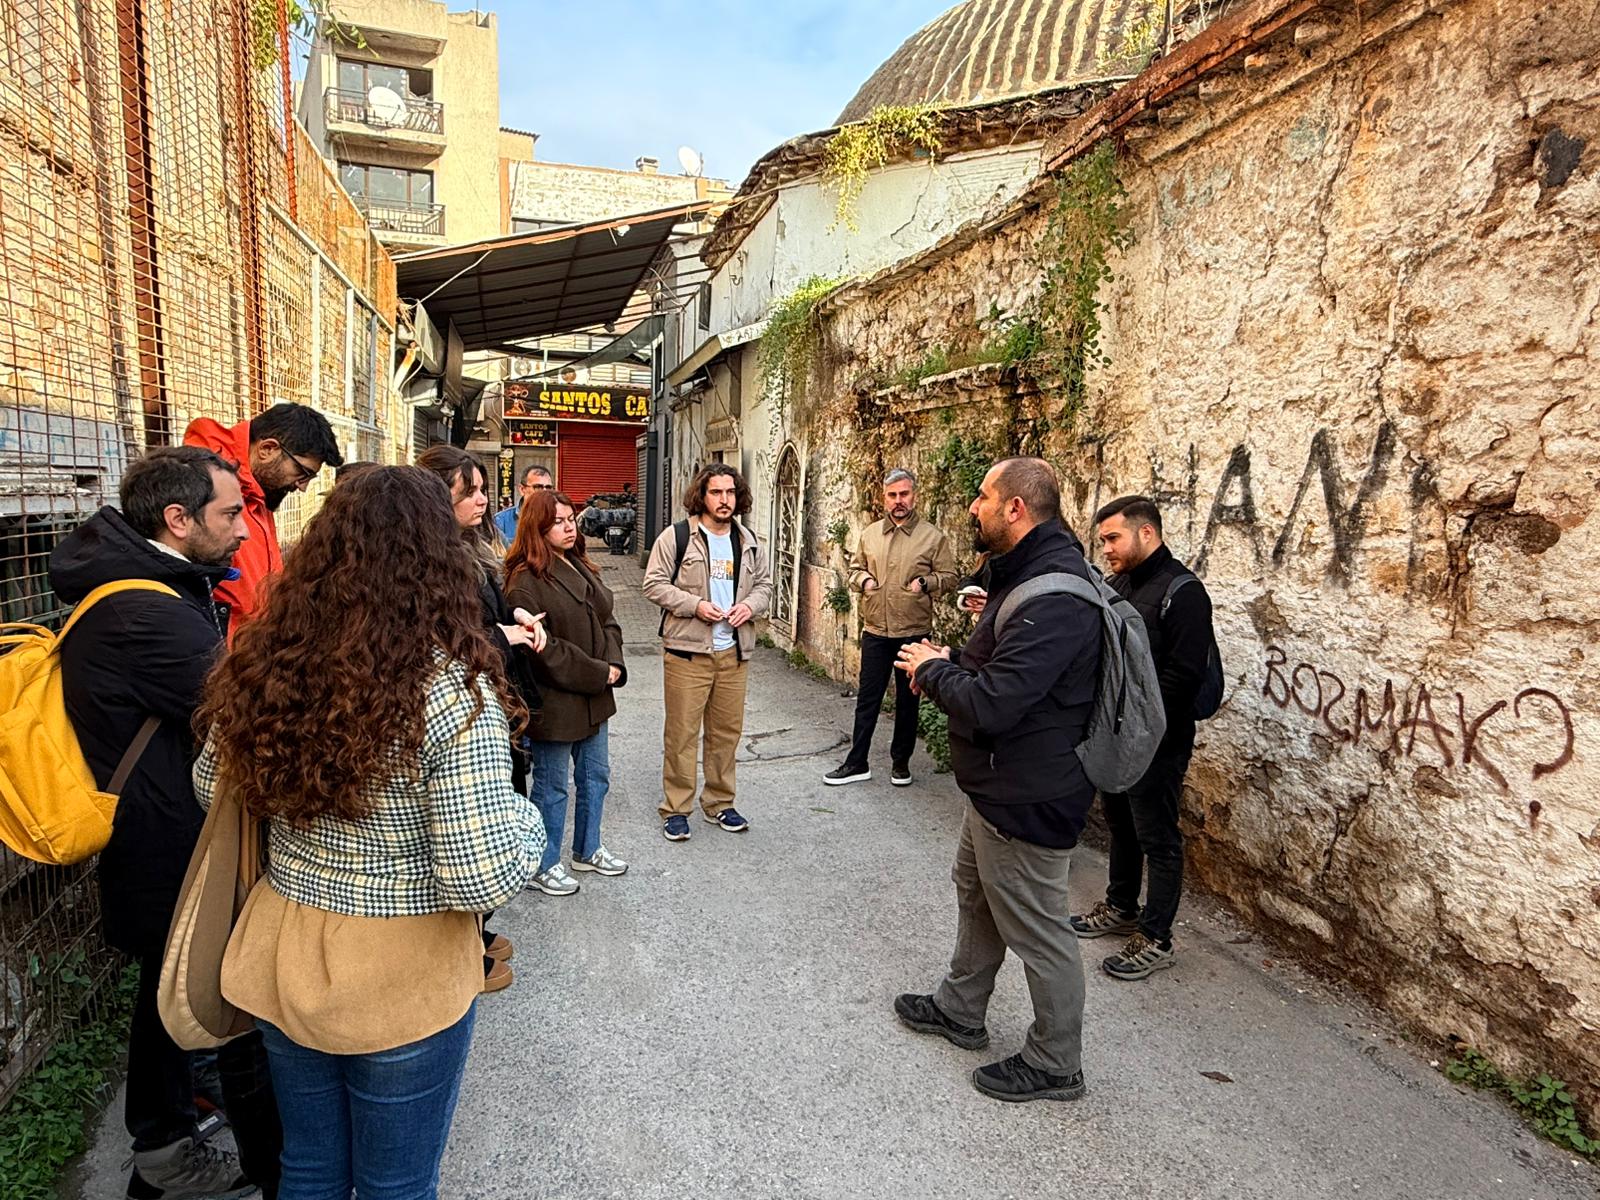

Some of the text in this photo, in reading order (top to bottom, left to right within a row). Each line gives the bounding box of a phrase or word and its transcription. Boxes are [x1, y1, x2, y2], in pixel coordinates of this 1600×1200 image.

[539, 391, 648, 416] SANTOS CA
[520, 423, 548, 431] SANTOS
